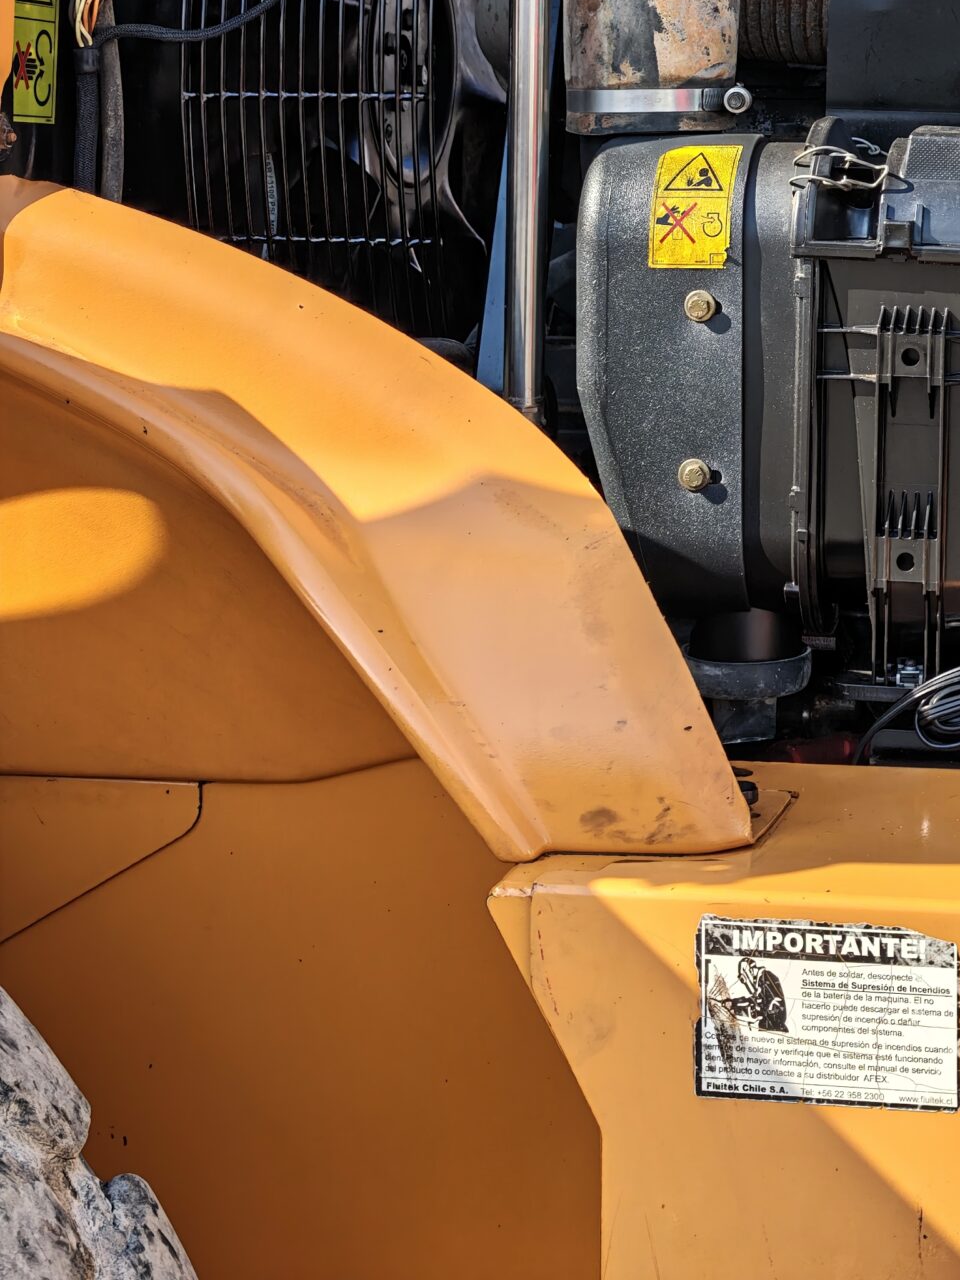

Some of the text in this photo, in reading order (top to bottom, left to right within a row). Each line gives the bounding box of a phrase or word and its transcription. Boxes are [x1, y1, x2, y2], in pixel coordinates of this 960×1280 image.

[732, 928, 926, 960] IMPORTANTE!
[801, 968, 825, 977] Antes
[826, 969, 837, 978] de
[867, 972, 913, 982] desconecte
[801, 979, 951, 994] Sistema de Supresión de Incendios
[801, 990, 812, 998] de
[813, 991, 821, 999] la
[853, 993, 864, 1001] de
[865, 994, 873, 1002] la
[913, 996, 922, 1004] El
[801, 1001, 831, 1010] hacerlo
[832, 1004, 858, 1012] puede
[860, 1005, 900, 1015] descargar
[901, 1007, 909, 1015] el
[943, 1009, 954, 1017] de
[801, 1013, 840, 1022] supresión
[842, 1015, 853, 1023] de
[854, 1016, 889, 1025] incendio
[801, 1025, 855, 1034] componentes
[856, 1026, 869, 1035] del
[751, 1036, 776, 1044] nuevo
[777, 1036, 785, 1045] el
[786, 1037, 817, 1046] sistema
[819, 1038, 830, 1046] de
[831, 1039, 870, 1049] supresión
[871, 1041, 883, 1050] de
[884, 1042, 922, 1052] incendios
[924, 1046, 954, 1054] cuando
[735, 1045, 746, 1053] de
[747, 1046, 772, 1054] soldar
[773, 1048, 779, 1057] y
[780, 1048, 815, 1058] verifique
[816, 1050, 831, 1059] que
[833, 1051, 841, 1059] el
[842, 1052, 873, 1061] sistema
[894, 1054, 944, 1065] funcionando
[718, 1065, 753, 1075] producto
[761, 1069, 795, 1078] contacte
[816, 1071, 860, 1081] distribuidor
[746, 1057, 771, 1066] mayor
[823, 1061, 857, 1070] consulte
[858, 1063, 866, 1071] el
[867, 1064, 898, 1072] manual
[898, 1065, 910, 1073] de
[706, 1081, 740, 1092] Fluitek
[741, 1083, 767, 1093] Chile
[769, 1085, 789, 1095] S.A.
[834, 1090, 845, 1098] 22
[864, 1092, 885, 1101] 2300
